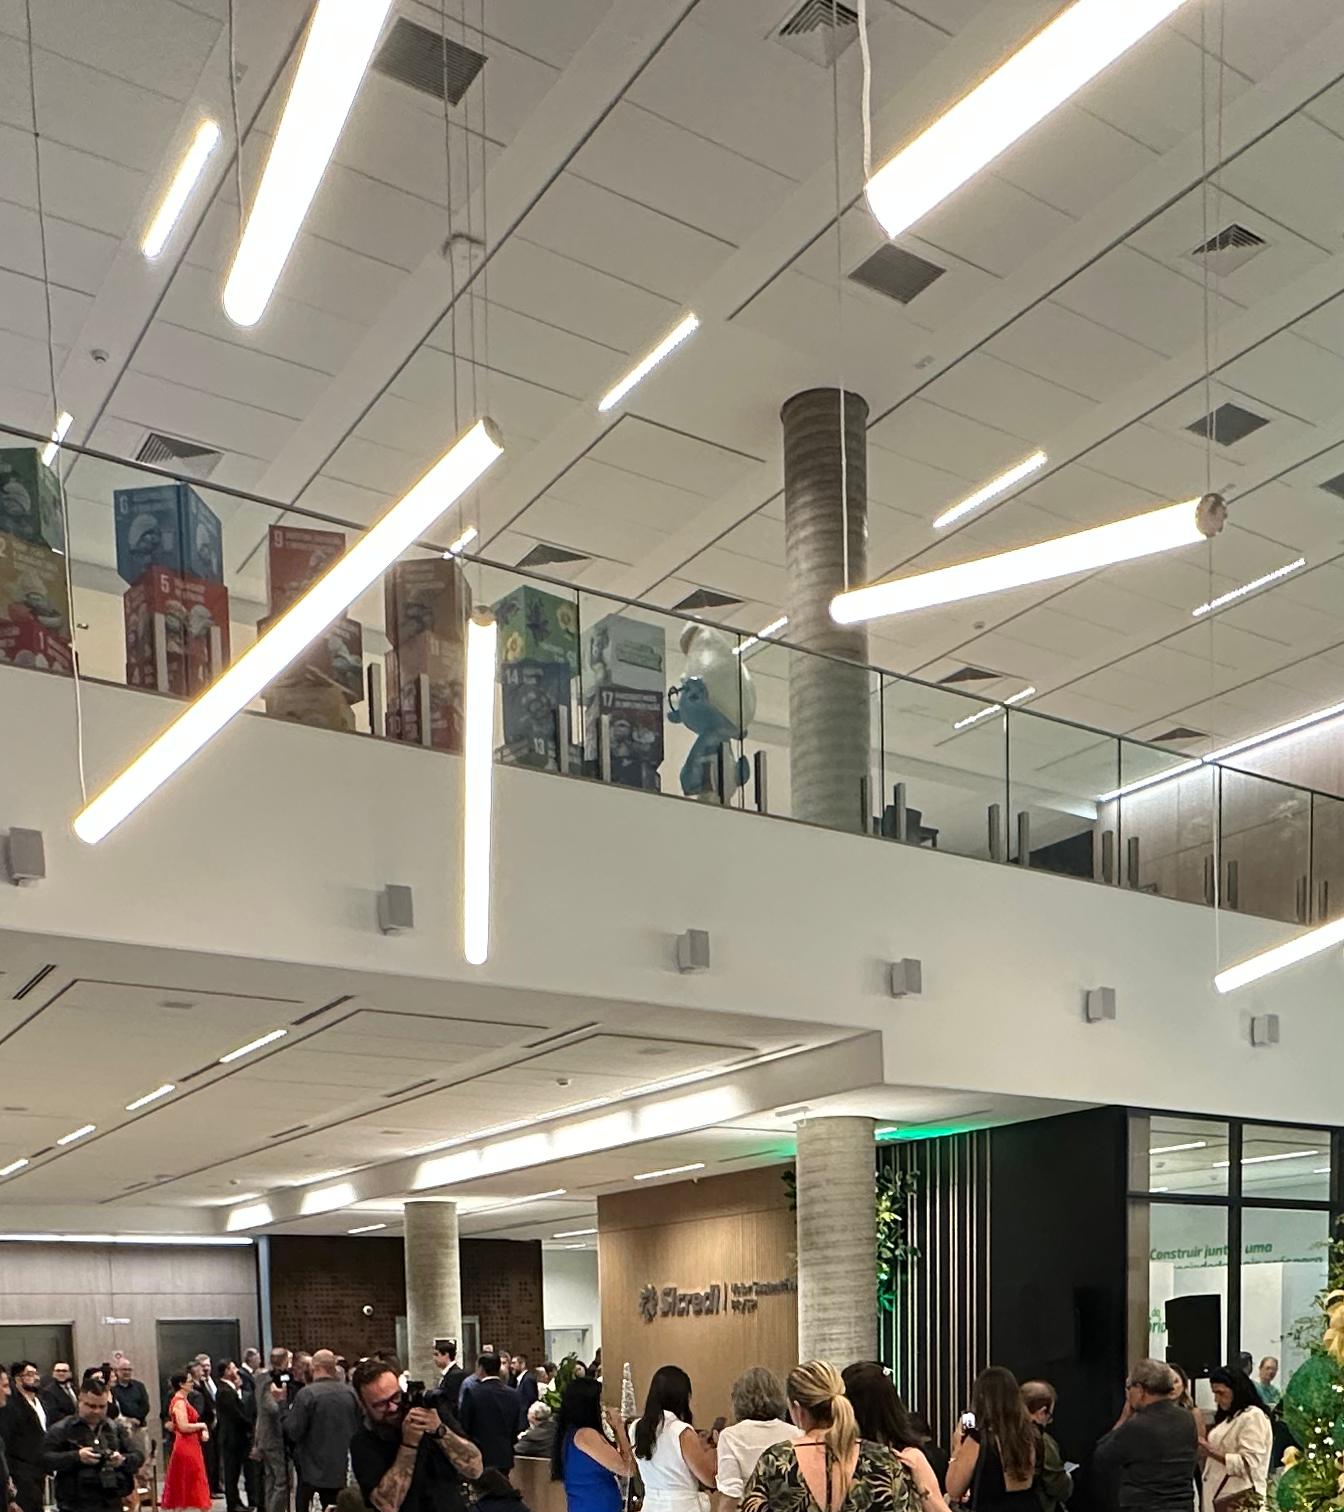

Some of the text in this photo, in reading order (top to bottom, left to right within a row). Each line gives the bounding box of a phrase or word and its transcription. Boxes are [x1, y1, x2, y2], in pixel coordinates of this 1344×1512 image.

[159, 574, 170, 593] 5
[601, 691, 614, 707] 17
[1150, 1245, 1203, 1260] Construir
[1204, 1244, 1228, 1259] junt
[660, 1284, 721, 1317] Sicredi
